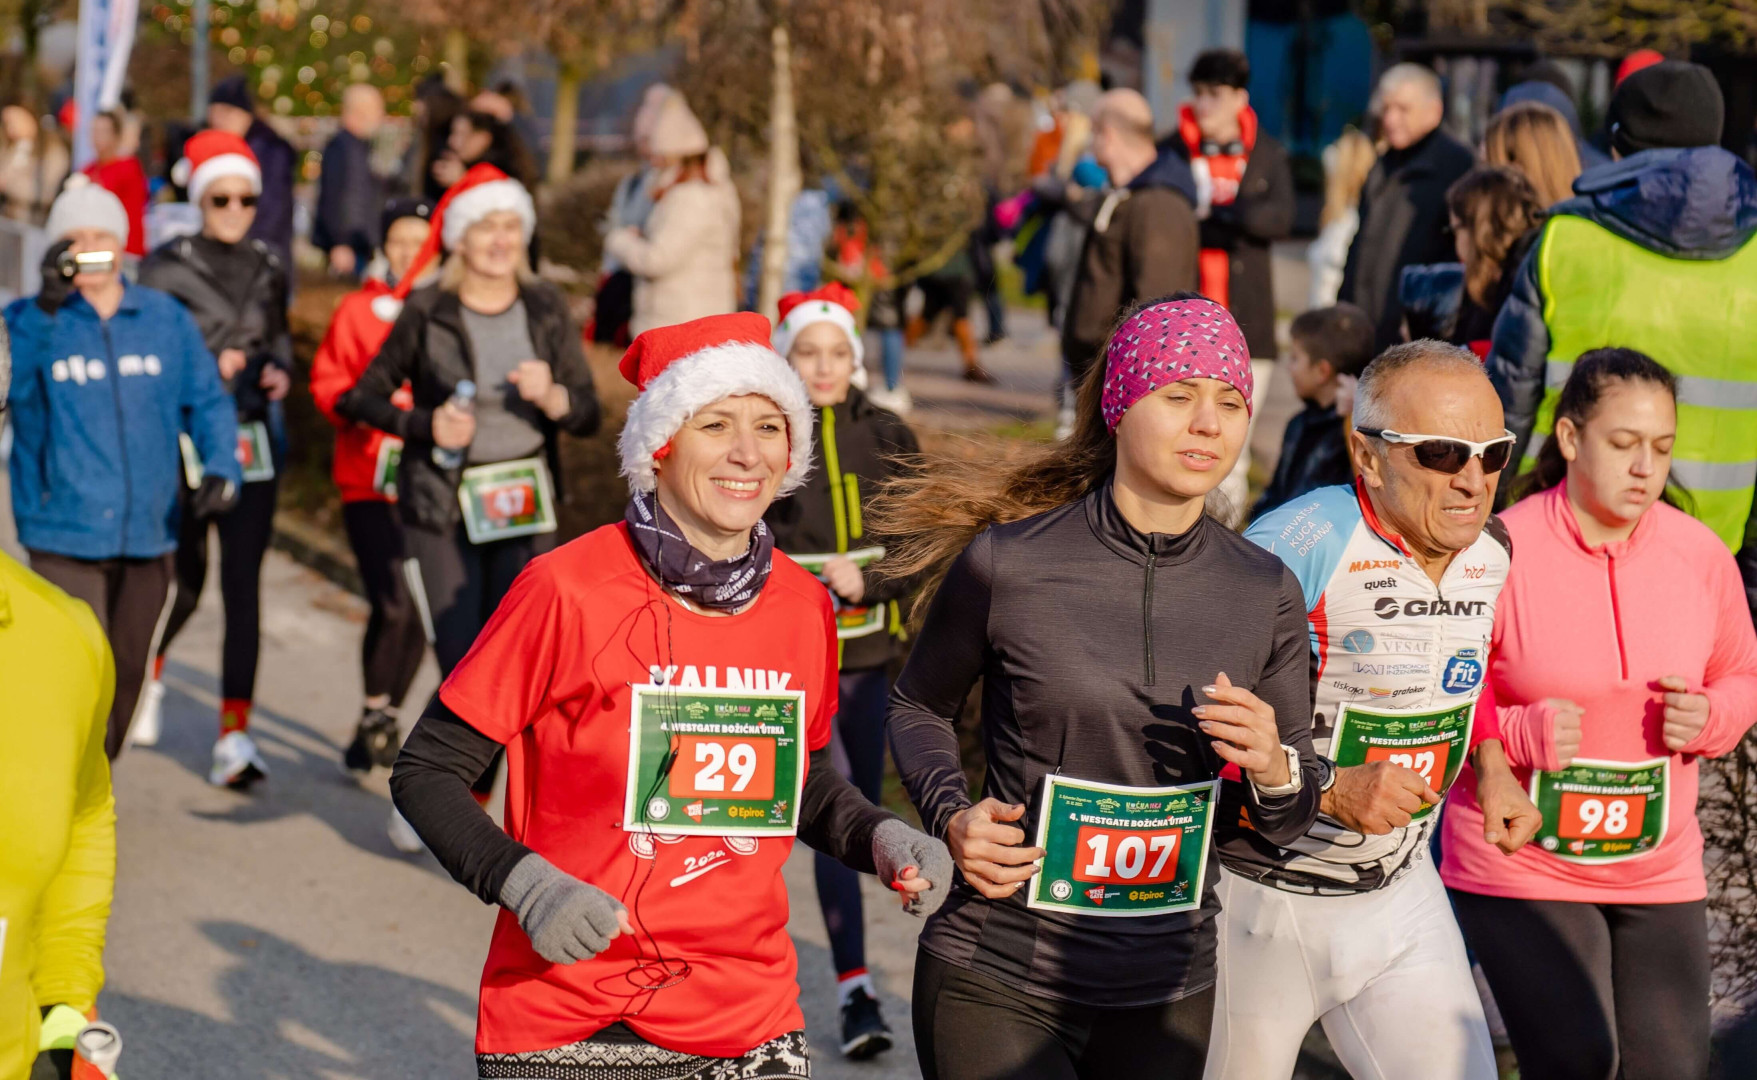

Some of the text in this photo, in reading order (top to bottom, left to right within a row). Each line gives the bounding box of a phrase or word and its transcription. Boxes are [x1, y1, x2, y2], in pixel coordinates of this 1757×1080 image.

[1280, 503, 1320, 540] HRVATSKA
[1298, 520, 1334, 557] DISANJA
[1349, 559, 1400, 573] MAXXIS
[1364, 577, 1398, 590] quest
[1403, 600, 1487, 617] GIANT
[1446, 661, 1478, 688] fit
[1391, 685, 1426, 698] grafokor
[660, 721, 785, 735] 4. WESTGATE BOŽIĆNA UTRKA
[1359, 735, 1368, 743] 4.
[1369, 736, 1411, 746] WESTGATE
[694, 742, 757, 792] 29
[739, 806, 765, 819] Epiroc
[1069, 812, 1193, 828] 4. WESTGATE BOŽIĆNA UTRKA
[1578, 798, 1629, 835] 98
[1084, 834, 1177, 879] 107
[1138, 890, 1165, 902] Epiroc
